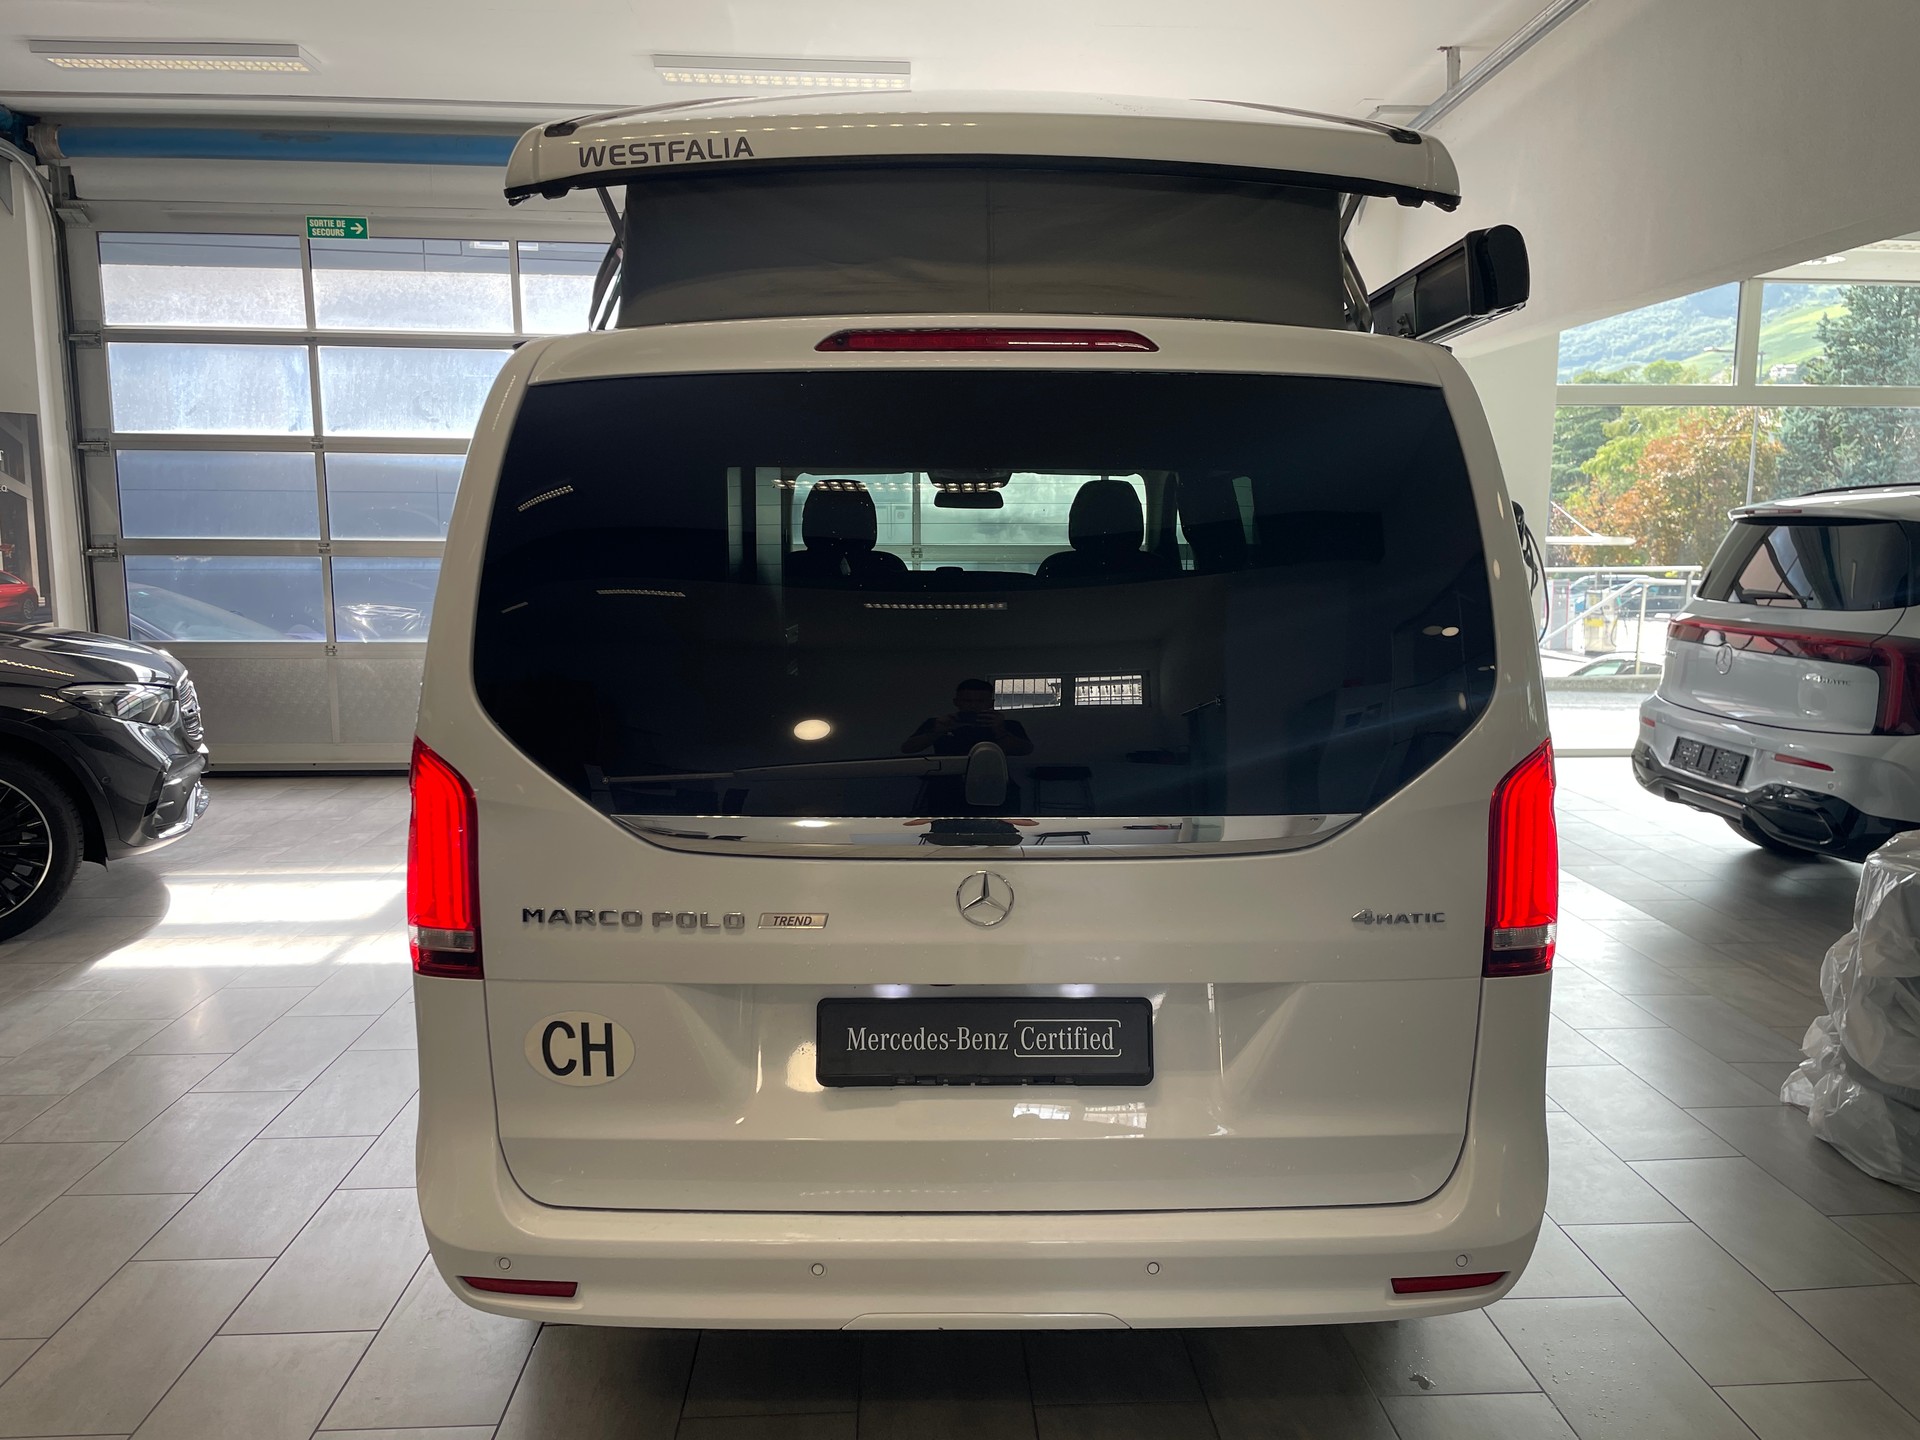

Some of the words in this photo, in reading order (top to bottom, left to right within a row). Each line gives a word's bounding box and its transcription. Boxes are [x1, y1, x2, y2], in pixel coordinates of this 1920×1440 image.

[578, 136, 754, 168] WESTFALIA
[309, 219, 335, 228] SORTIE
[336, 220, 346, 228] DE
[311, 228, 345, 237] SECOURS
[522, 906, 644, 927] MARCO
[651, 910, 746, 929] POLO
[772, 914, 813, 927] TREND
[1351, 908, 1446, 925] 4MATIC
[542, 1020, 615, 1077] CH
[846, 1025, 1009, 1052] Mercedes-Benz
[1019, 1025, 1115, 1051] Certified
